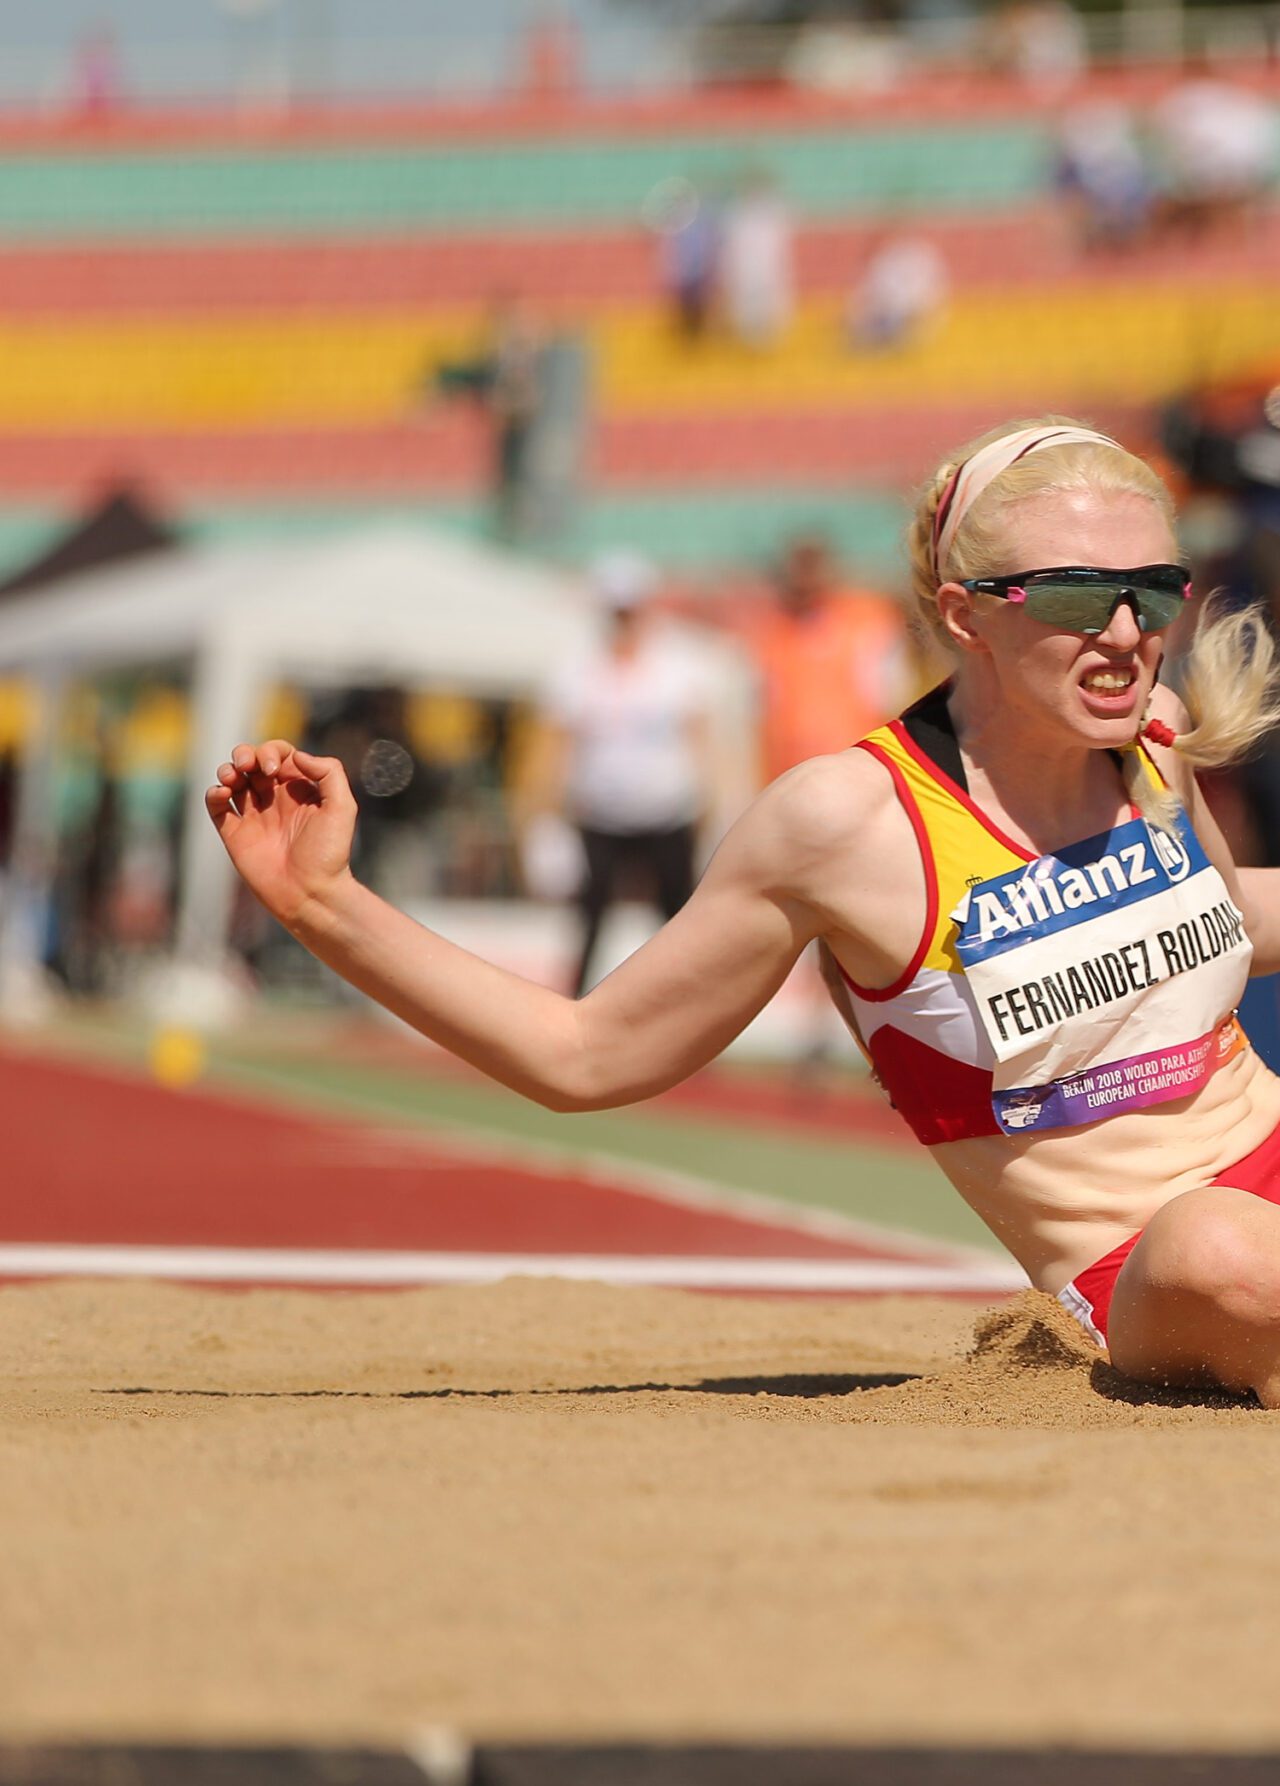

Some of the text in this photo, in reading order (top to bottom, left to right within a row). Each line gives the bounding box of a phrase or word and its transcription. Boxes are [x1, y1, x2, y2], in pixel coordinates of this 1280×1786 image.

[972, 841, 1157, 943] Allianz
[986, 899, 1244, 1042] FERNANDEZ ROLDAN
[1062, 1077, 1095, 1099] BERLIN
[1097, 1070, 1123, 1088] 2018
[1124, 1059, 1160, 1082] WOLRD
[1160, 1053, 1187, 1072] PARA
[1087, 1083, 1137, 1109] EUROPEAN
